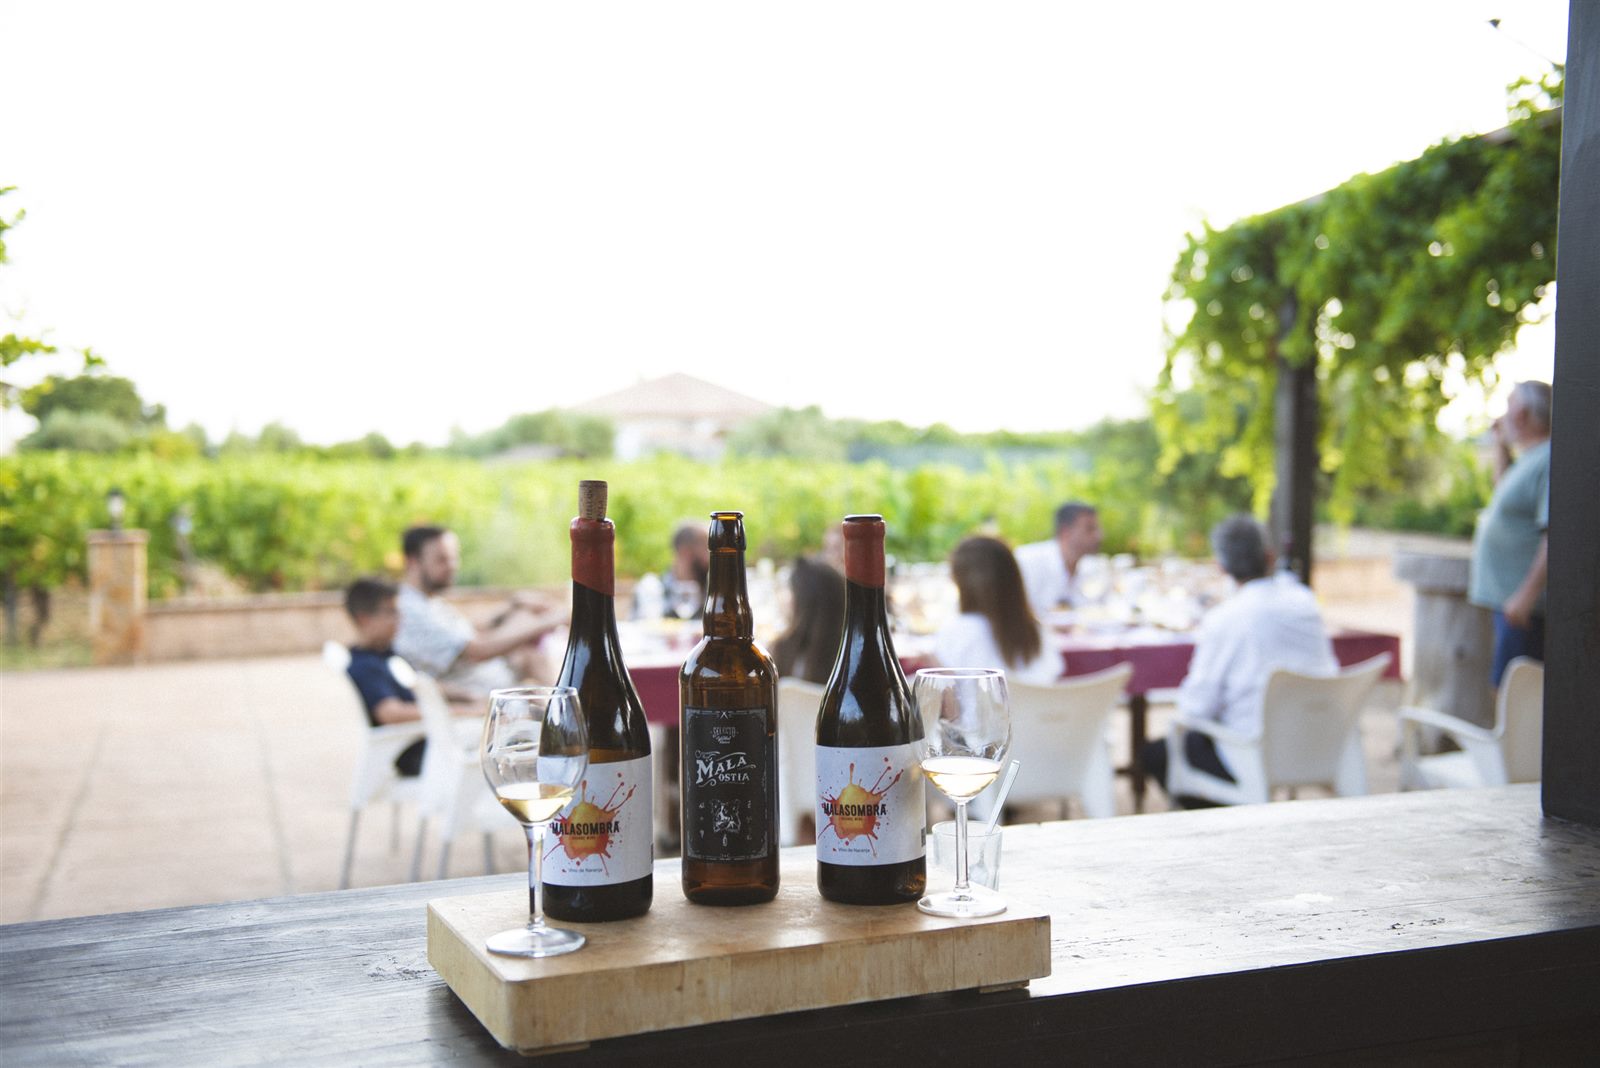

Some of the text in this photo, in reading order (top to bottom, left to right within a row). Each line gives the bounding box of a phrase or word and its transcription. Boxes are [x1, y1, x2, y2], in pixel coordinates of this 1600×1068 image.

[695, 756, 747, 784] MALA
[718, 773, 750, 782] OSTIA
[823, 802, 887, 816] MALASOMBRA
[551, 821, 620, 835] MALASOMBRA
